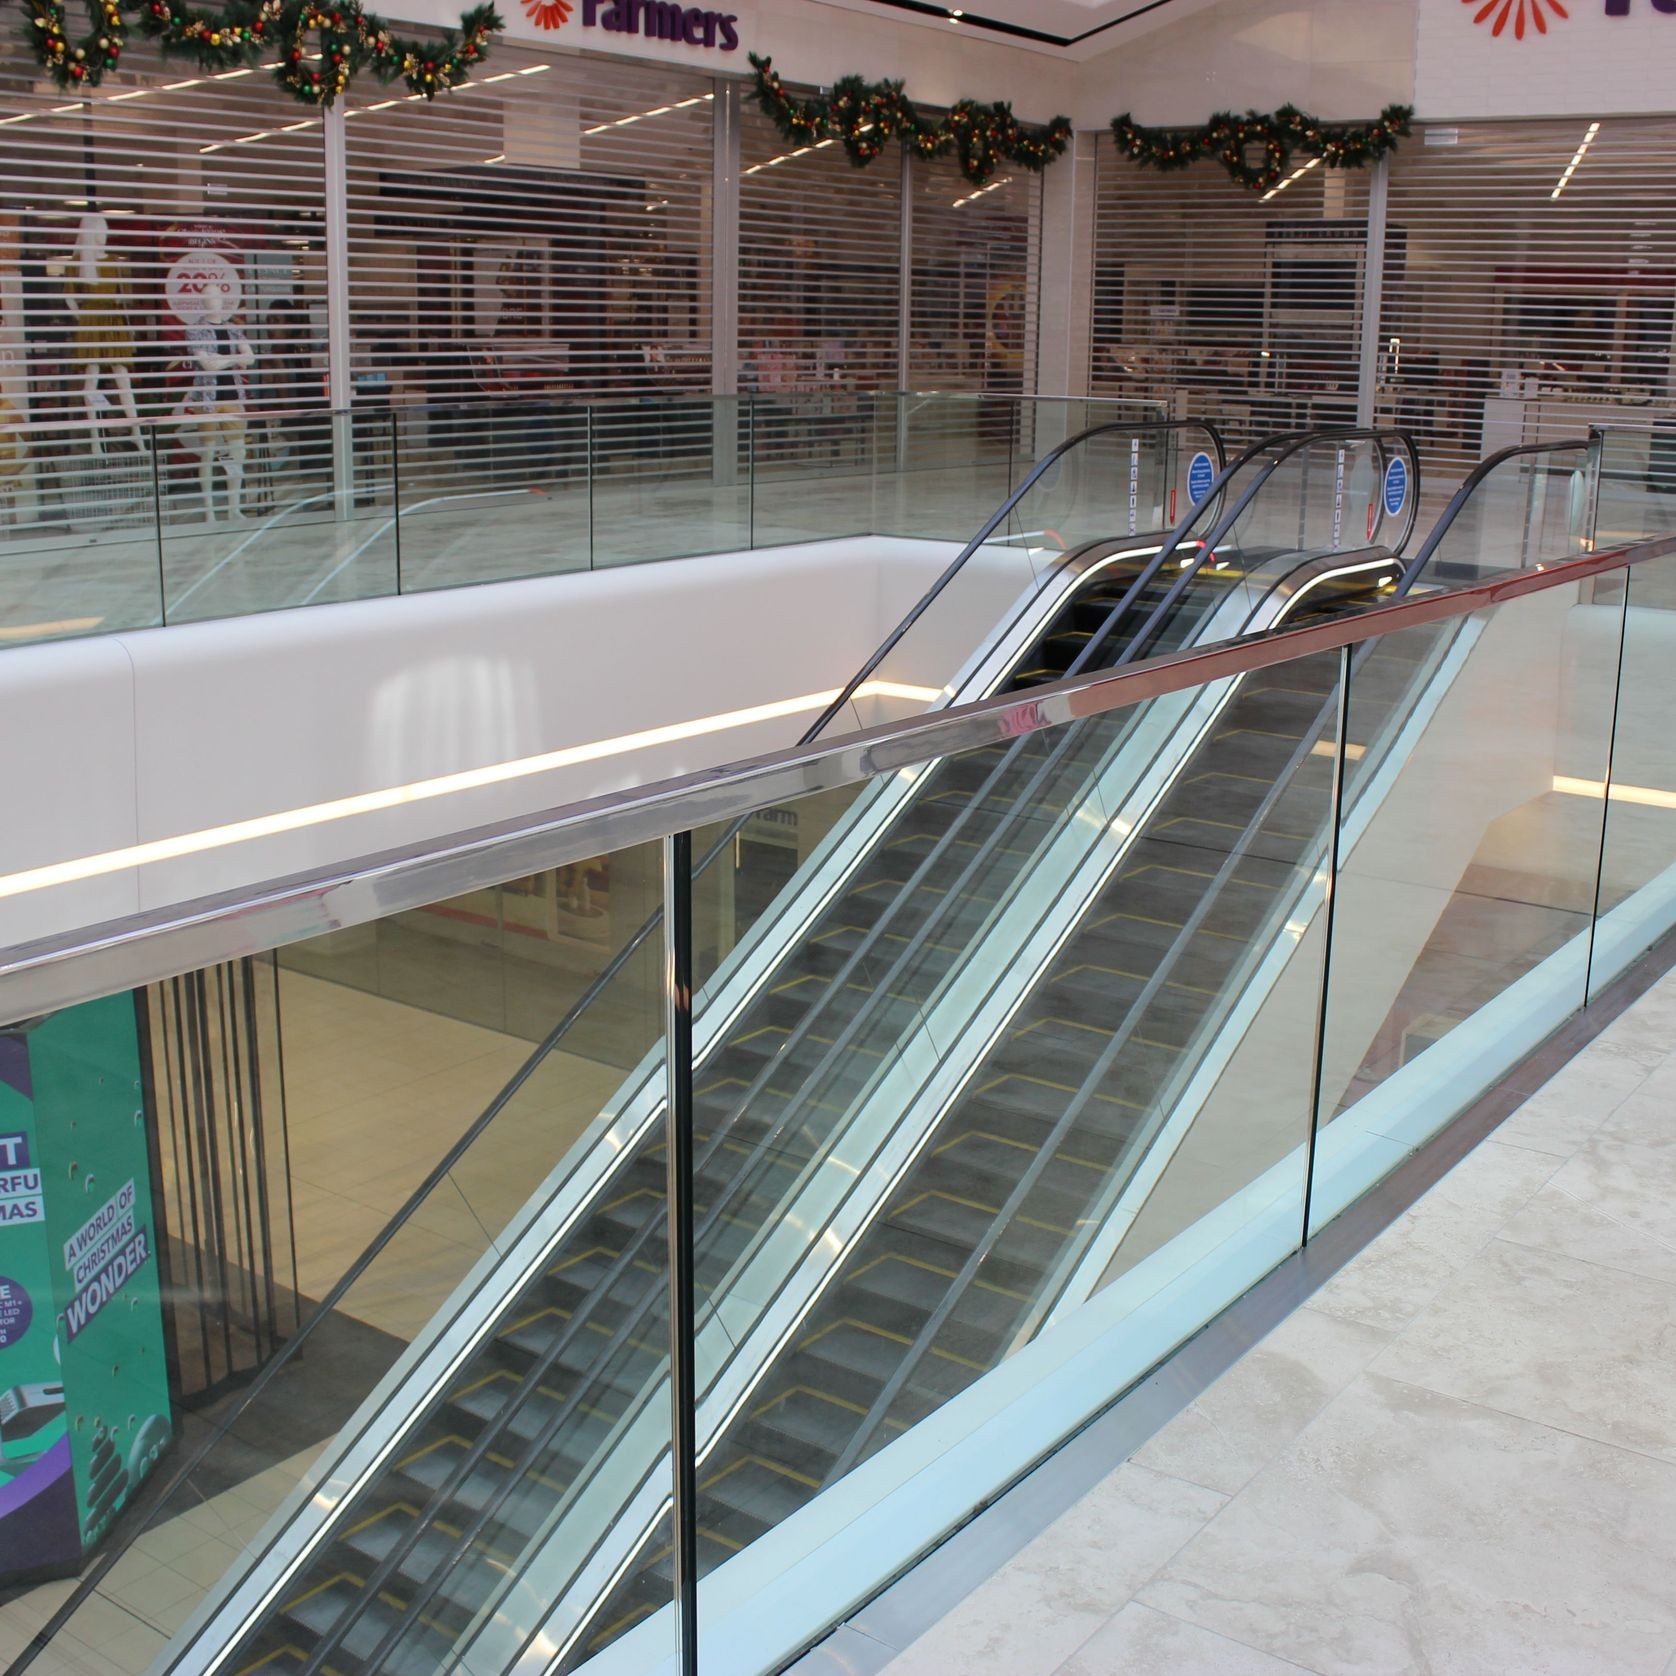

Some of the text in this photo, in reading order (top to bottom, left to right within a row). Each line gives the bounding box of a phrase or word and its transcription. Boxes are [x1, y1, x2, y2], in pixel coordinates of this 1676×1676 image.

[176, 272, 231, 293] 20%
[0, 1173, 39, 1193] RFU
[67, 1185, 132, 1262] A WORLD OF
[76, 1215, 133, 1284] CHRISTMAS
[66, 1232, 148, 1334] WONDER
